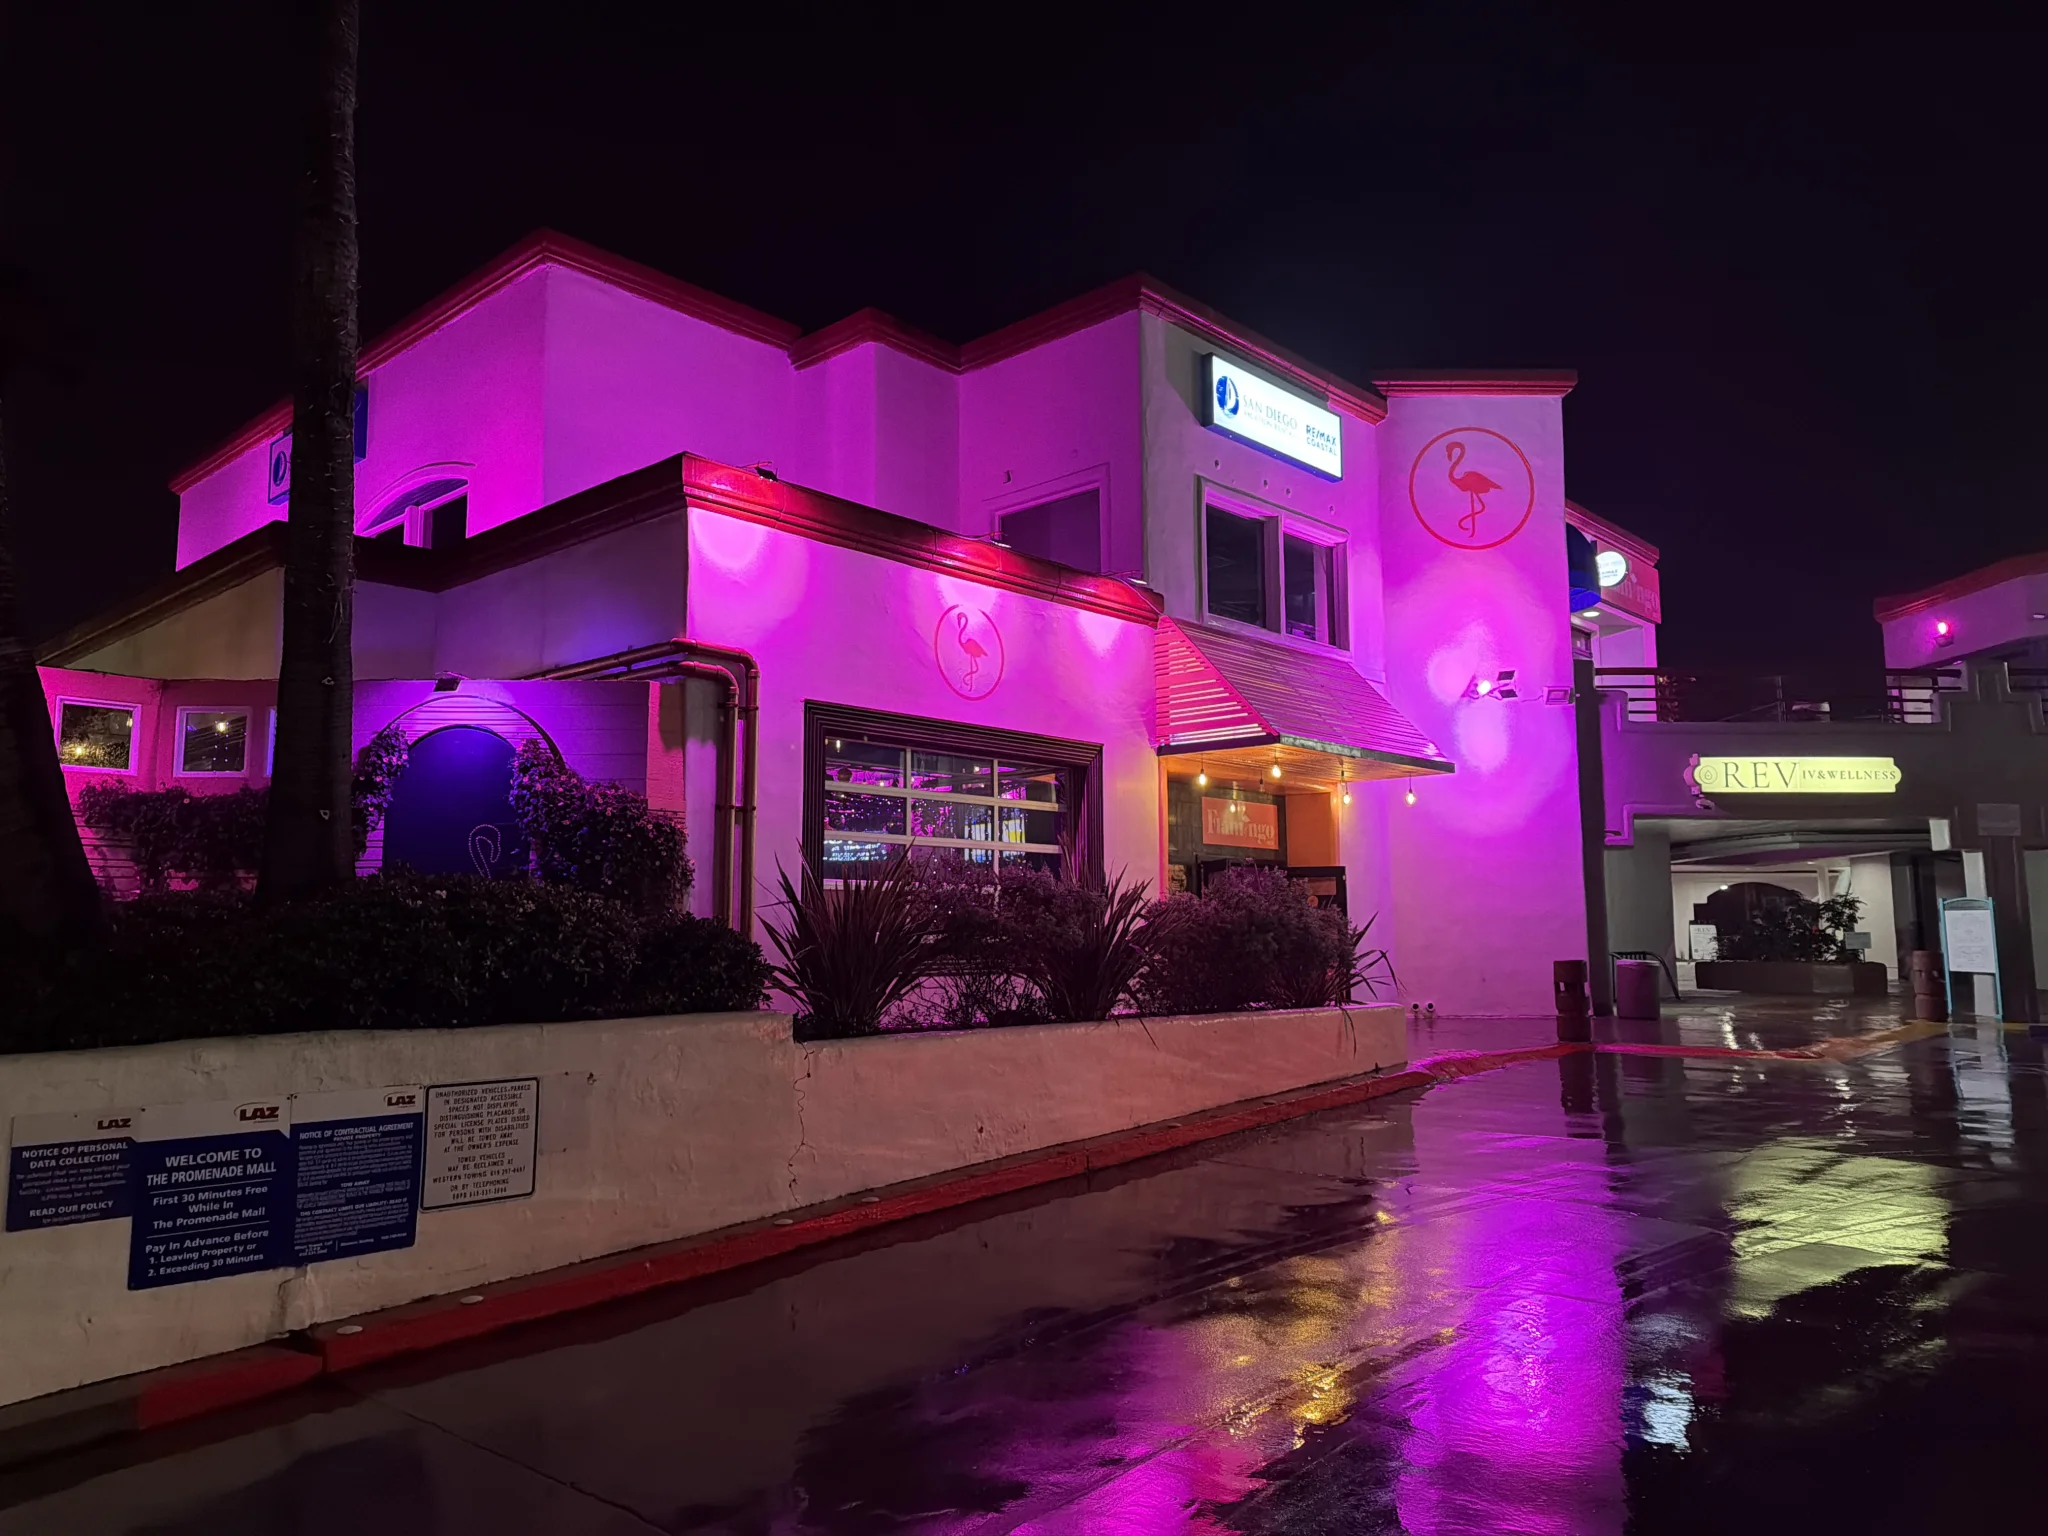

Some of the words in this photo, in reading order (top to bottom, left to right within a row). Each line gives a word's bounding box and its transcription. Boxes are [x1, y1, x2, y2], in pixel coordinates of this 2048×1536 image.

[1243, 394, 1262, 414] SAN
[1266, 405, 1298, 430] DIEGO
[1306, 424, 1337, 446] RE/MAX
[1306, 437, 1337, 456] COASTAL
[1722, 762, 1798, 788] REV
[1802, 770, 1896, 780] IV&WELLNESS
[387, 1094, 416, 1107] LAZ
[435, 1088, 478, 1098] UNAUTHORIZED
[453, 1095, 487, 1104] DESIGNATED
[490, 1092, 522, 1101] ACCESSIBLE
[487, 1100, 518, 1109] DISPLAYING
[240, 1106, 280, 1121] LAZ
[439, 1111, 483, 1121] DISTINGUISHING
[486, 1108, 514, 1116] PLACARDS
[97, 1118, 132, 1130] LAZ
[434, 1122, 456, 1130] SPECIAL
[461, 1119, 483, 1127] LICENSE
[511, 1114, 530, 1122] ISSUED
[449, 1128, 474, 1136] PERSONS
[495, 1122, 528, 1131] DISABILITIES
[299, 1131, 323, 1140] NOTICE
[324, 1130, 333, 1138] OF
[334, 1126, 377, 1136] CONTRACTUAL
[379, 1122, 414, 1132] AGREEMENT
[22, 1148, 59, 1158] NOTICE
[62, 1146, 76, 1155] OF
[78, 1142, 128, 1154] PERSONAL
[495, 1139, 518, 1147] EXPENSE
[30, 1160, 56, 1169] DATA
[59, 1153, 120, 1166] COLLECTION
[166, 1150, 240, 1168] WELCOME
[244, 1148, 262, 1159] TO
[457, 1155, 475, 1163] TOWED
[479, 1152, 505, 1160] VEHICLES
[473, 1160, 504, 1168] RECLAIMED
[146, 1174, 168, 1186] THE
[171, 1165, 244, 1184] PROMENADE
[246, 1161, 276, 1175] MALL
[432, 1174, 461, 1183] WESTERN
[464, 1171, 486, 1179] TOWING
[472, 1178, 508, 1188] TELEPHONING
[153, 1196, 178, 1206] First
[182, 1193, 195, 1202] 30
[198, 1189, 242, 1200] Minutes
[245, 1186, 268, 1196] Free
[30, 1208, 56, 1218] READ
[58, 1206, 78, 1214] OUR
[80, 1200, 114, 1212] POLICY
[188, 1202, 220, 1213] While
[223, 1200, 234, 1209] In
[153, 1220, 172, 1230] The
[176, 1210, 239, 1226] Promenade
[242, 1207, 265, 1218] Mall
[145, 1244, 166, 1254] Pay
[169, 1241, 180, 1250] In
[184, 1234, 231, 1248] Advance
[234, 1229, 270, 1241] Before
[149, 1256, 158, 1264] 1.
[160, 1250, 199, 1263] Leaving
[201, 1244, 244, 1260] Property
[246, 1242, 256, 1250] or
[148, 1268, 157, 1277] 2.
[160, 1260, 210, 1275] Exceeding
[212, 1258, 224, 1268] 30
[226, 1253, 264, 1266] Minutes
